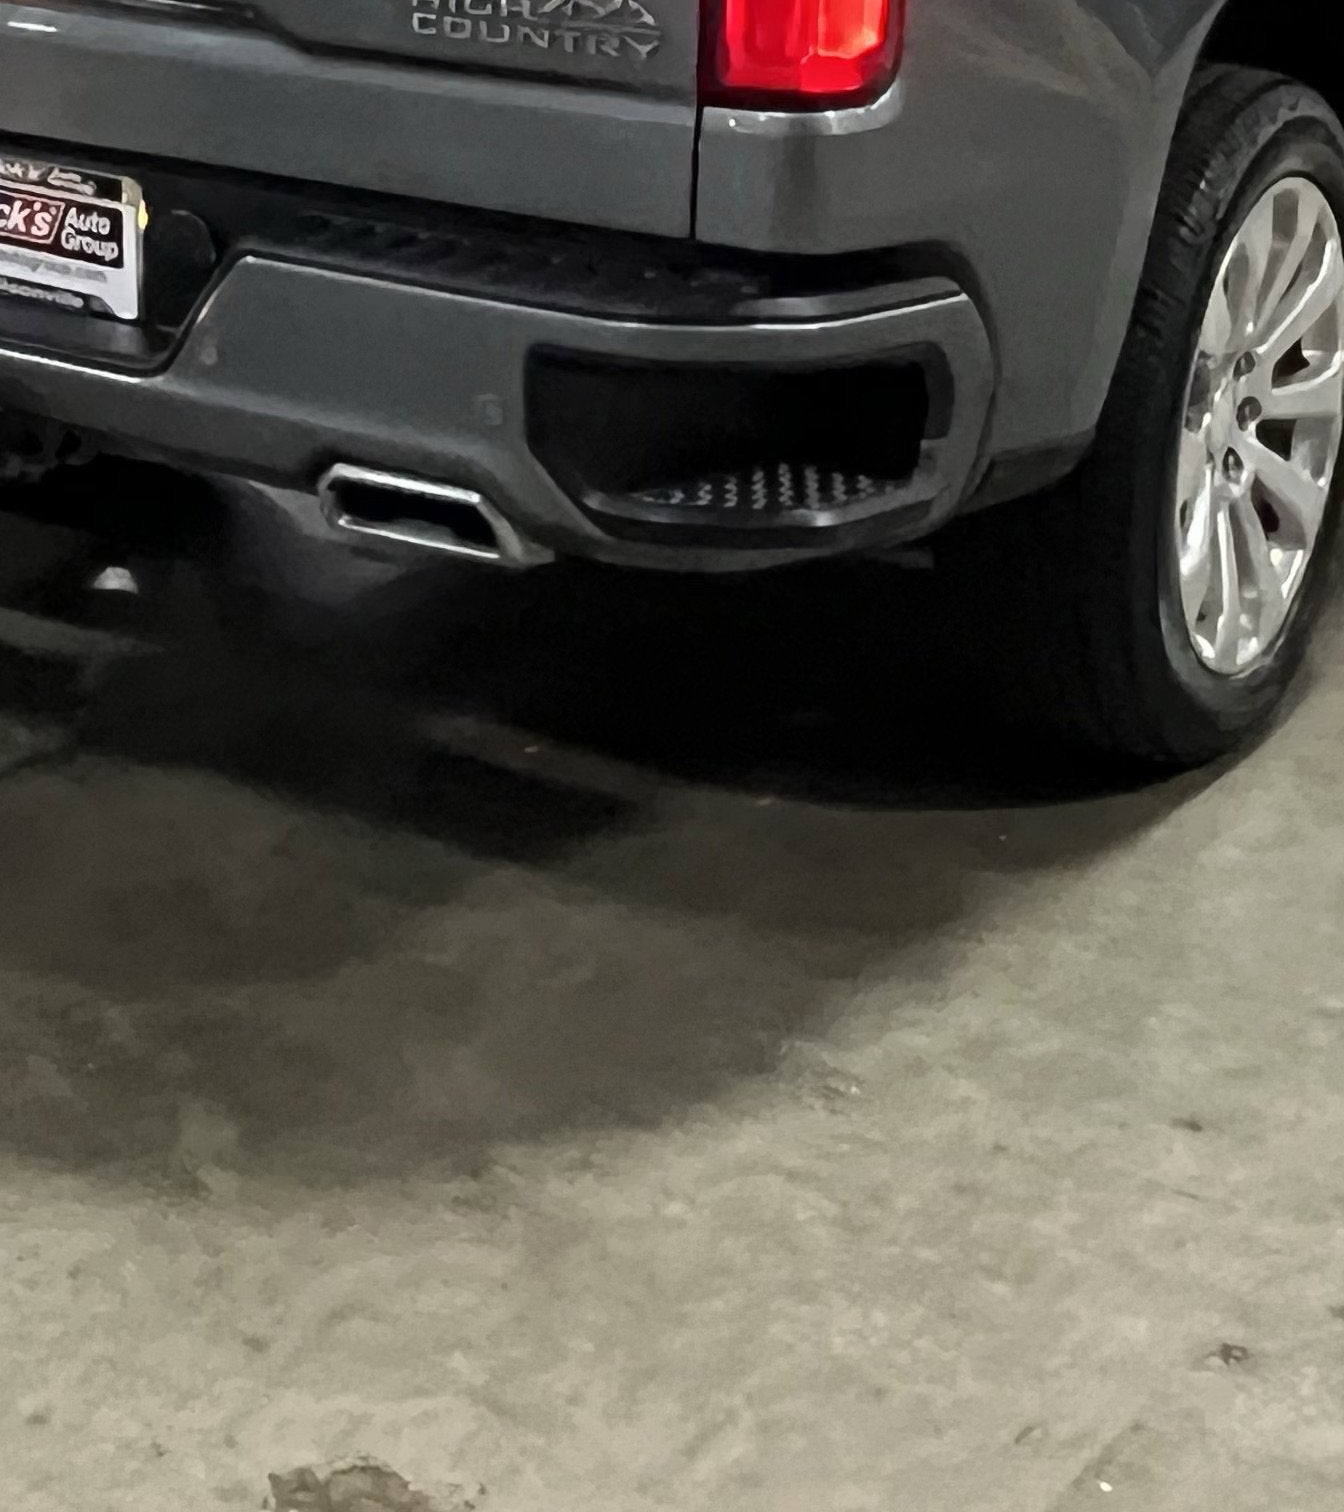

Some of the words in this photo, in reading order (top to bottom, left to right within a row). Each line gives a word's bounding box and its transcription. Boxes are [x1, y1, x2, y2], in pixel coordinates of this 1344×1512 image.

[413, 12, 660, 58] COUNTRY
[64, 207, 111, 235] Auto
[61, 226, 119, 261] Group
